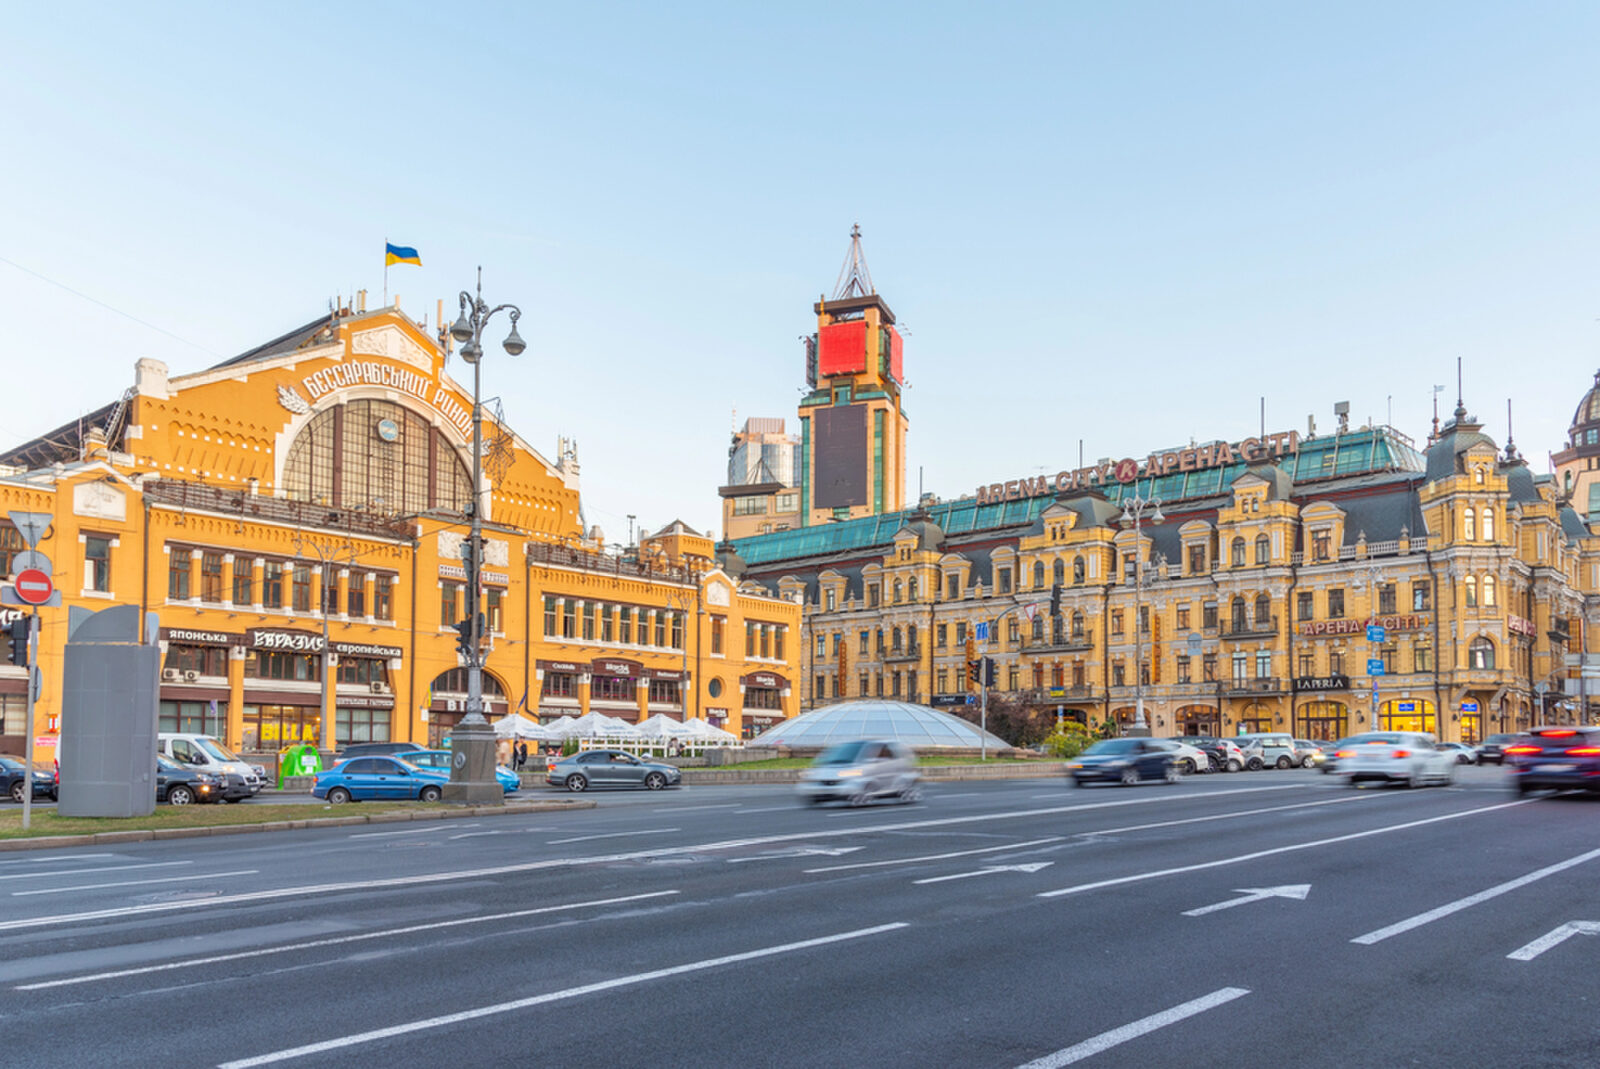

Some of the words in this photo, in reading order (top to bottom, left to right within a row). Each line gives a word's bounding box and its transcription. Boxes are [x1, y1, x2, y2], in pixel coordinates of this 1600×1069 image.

[976, 475, 1049, 505] ARENA
[1056, 463, 1110, 492] CITY
[1304, 619, 1360, 636] АРЕНА
[261, 723, 315, 741] BILLA
